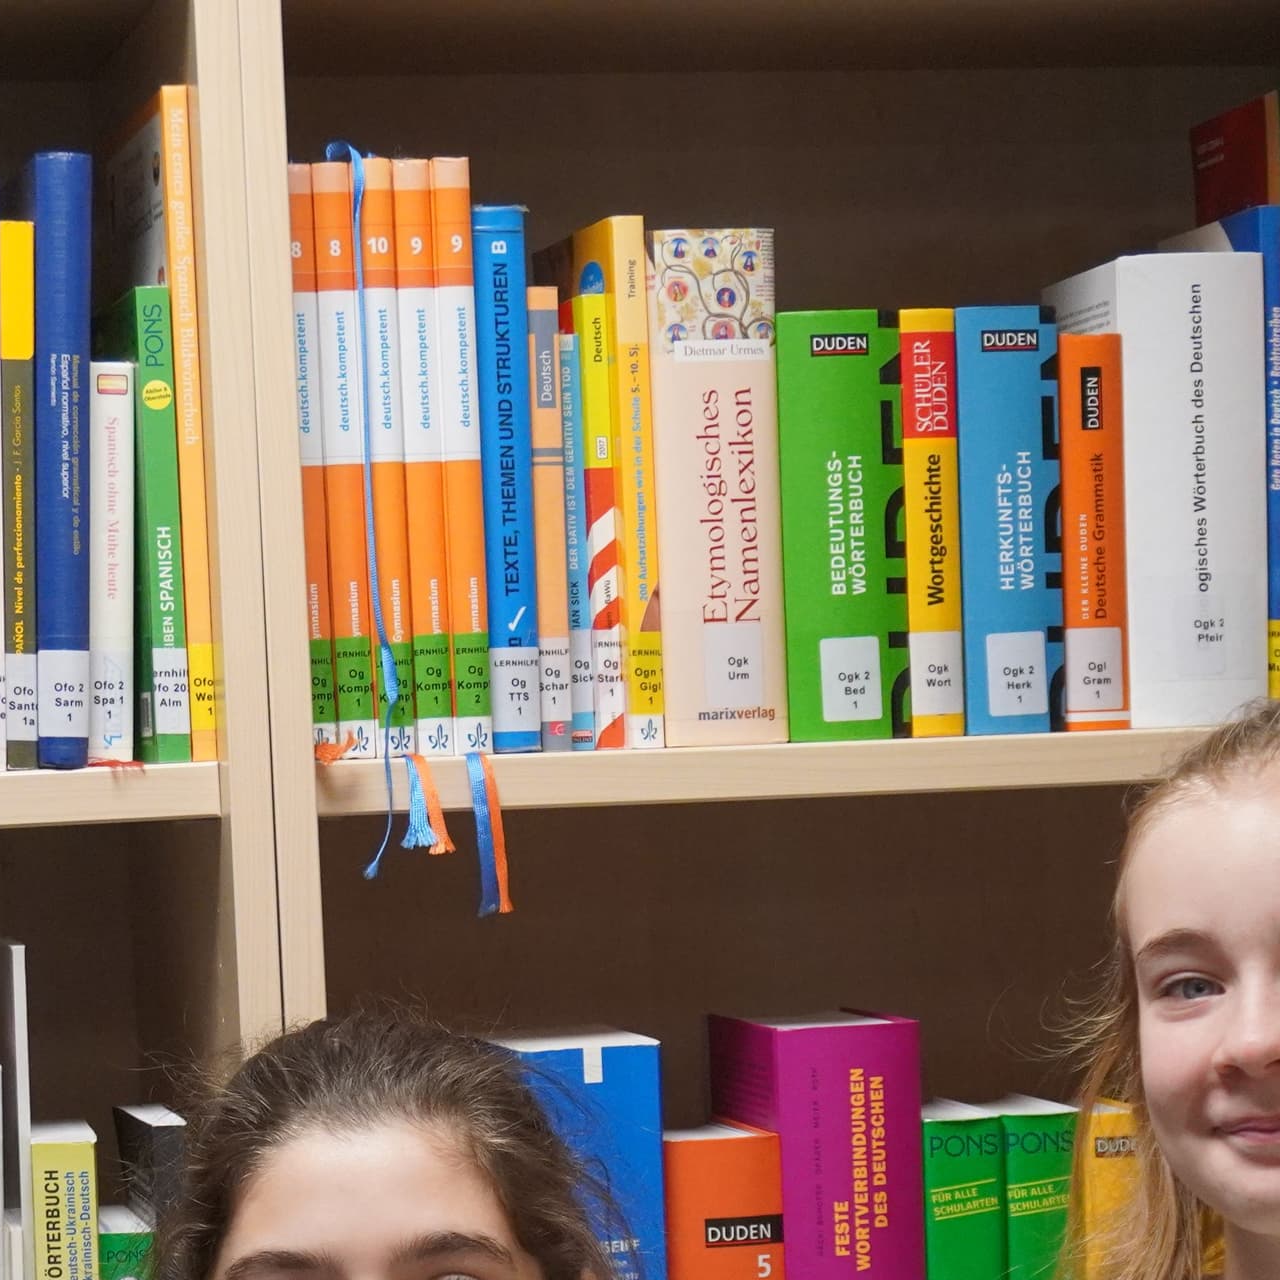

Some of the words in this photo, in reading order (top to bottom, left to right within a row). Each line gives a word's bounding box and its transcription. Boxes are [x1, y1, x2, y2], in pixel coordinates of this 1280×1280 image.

[329, 239, 342, 257] 8
[367, 237, 389, 254] 10
[410, 237, 423, 255] 9
[451, 235, 463, 253] 9
[490, 239, 508, 255] B
[627, 259, 638, 299] Training
[143, 303, 164, 368] PONS
[492, 262, 515, 397] STRUKTUREN
[593, 317, 604, 363] Deutsch
[812, 336, 868, 352] DUDEN
[982, 332, 1038, 348] DUDEN
[1189, 283, 1205, 374] Deutschen
[378, 306, 393, 430] deutsch.kompetent
[417, 308, 432, 430] deutsch.kompetent
[456, 306, 471, 428] deutsch.kompetent
[683, 345, 728, 358] Dietmar
[730, 343, 766, 357] Urmes
[60, 353, 71, 391] Español
[296, 312, 310, 433] deutsch.kompetent
[336, 310, 351, 432] deutsch.kompetent
[540, 349, 553, 402] Deutsch
[912, 339, 934, 432] SCHÜLER
[932, 360, 949, 431] DUDEN
[1087, 376, 1100, 429] DUDEN
[1192, 379, 1205, 408] des
[498, 407, 516, 440] UND
[61, 440, 71, 461] nivel
[565, 423, 575, 464] GENITIV
[61, 462, 71, 499] superior
[1192, 414, 1208, 513] Wörterbuch
[500, 441, 518, 526] THEMEN
[1088, 452, 1106, 541] Grammatik
[14, 474, 26, 568] perfeccionamiento
[696, 389, 732, 624] Etymologisches
[728, 387, 761, 624] Namenlexikon
[827, 450, 848, 596] BEDEUTUNGS-
[846, 455, 867, 595] WÖRTERBUCH
[1017, 451, 1035, 590] WÖRTERBUCH
[568, 511, 578, 546] DATIV
[923, 454, 948, 606] Wortgeschichte
[997, 463, 1016, 591] HERKUNFTS-
[1079, 513, 1089, 554] DUDEN
[16, 571, 25, 585] de
[107, 563, 119, 600] heute
[155, 526, 175, 612] SPANISCH
[504, 529, 521, 596] TEXTE,
[1081, 558, 1089, 600] KLEINE
[1094, 544, 1108, 620] Deutsche
[15, 586, 24, 614] Nivel
[392, 579, 402, 642] Gymnasium
[571, 580, 580, 605] SICK
[728, 657, 750, 668] Ogk
[728, 671, 750, 681] Urm
[838, 672, 862, 683] Ogk
[927, 664, 950, 675] Ogk
[1003, 667, 1026, 678] Ogk
[1082, 676, 1112, 686] Gram
[54, 683, 75, 693] Ofo
[94, 680, 116, 691] Ofo
[926, 678, 951, 688] Wort
[1007, 680, 1032, 690] Herk
[54, 698, 84, 708] Sarm
[698, 706, 776, 721] marixverlag
[869, 1075, 888, 1187] DEUTSCHEN
[929, 1134, 999, 1158] PONS
[844, 1067, 872, 1272] WORTVERBINDUNGEN
[875, 1188, 889, 1229] DES
[931, 1188, 952, 1204] FÜR
[954, 1186, 980, 1200] ALLE
[933, 1196, 999, 1216] SCHULARTEN
[1007, 1185, 1028, 1200] FÜR
[1030, 1183, 1055, 1196] ALLE
[707, 1223, 772, 1243] DUDEN
[833, 1200, 851, 1257] FESTE
[757, 1254, 772, 1278] 5
